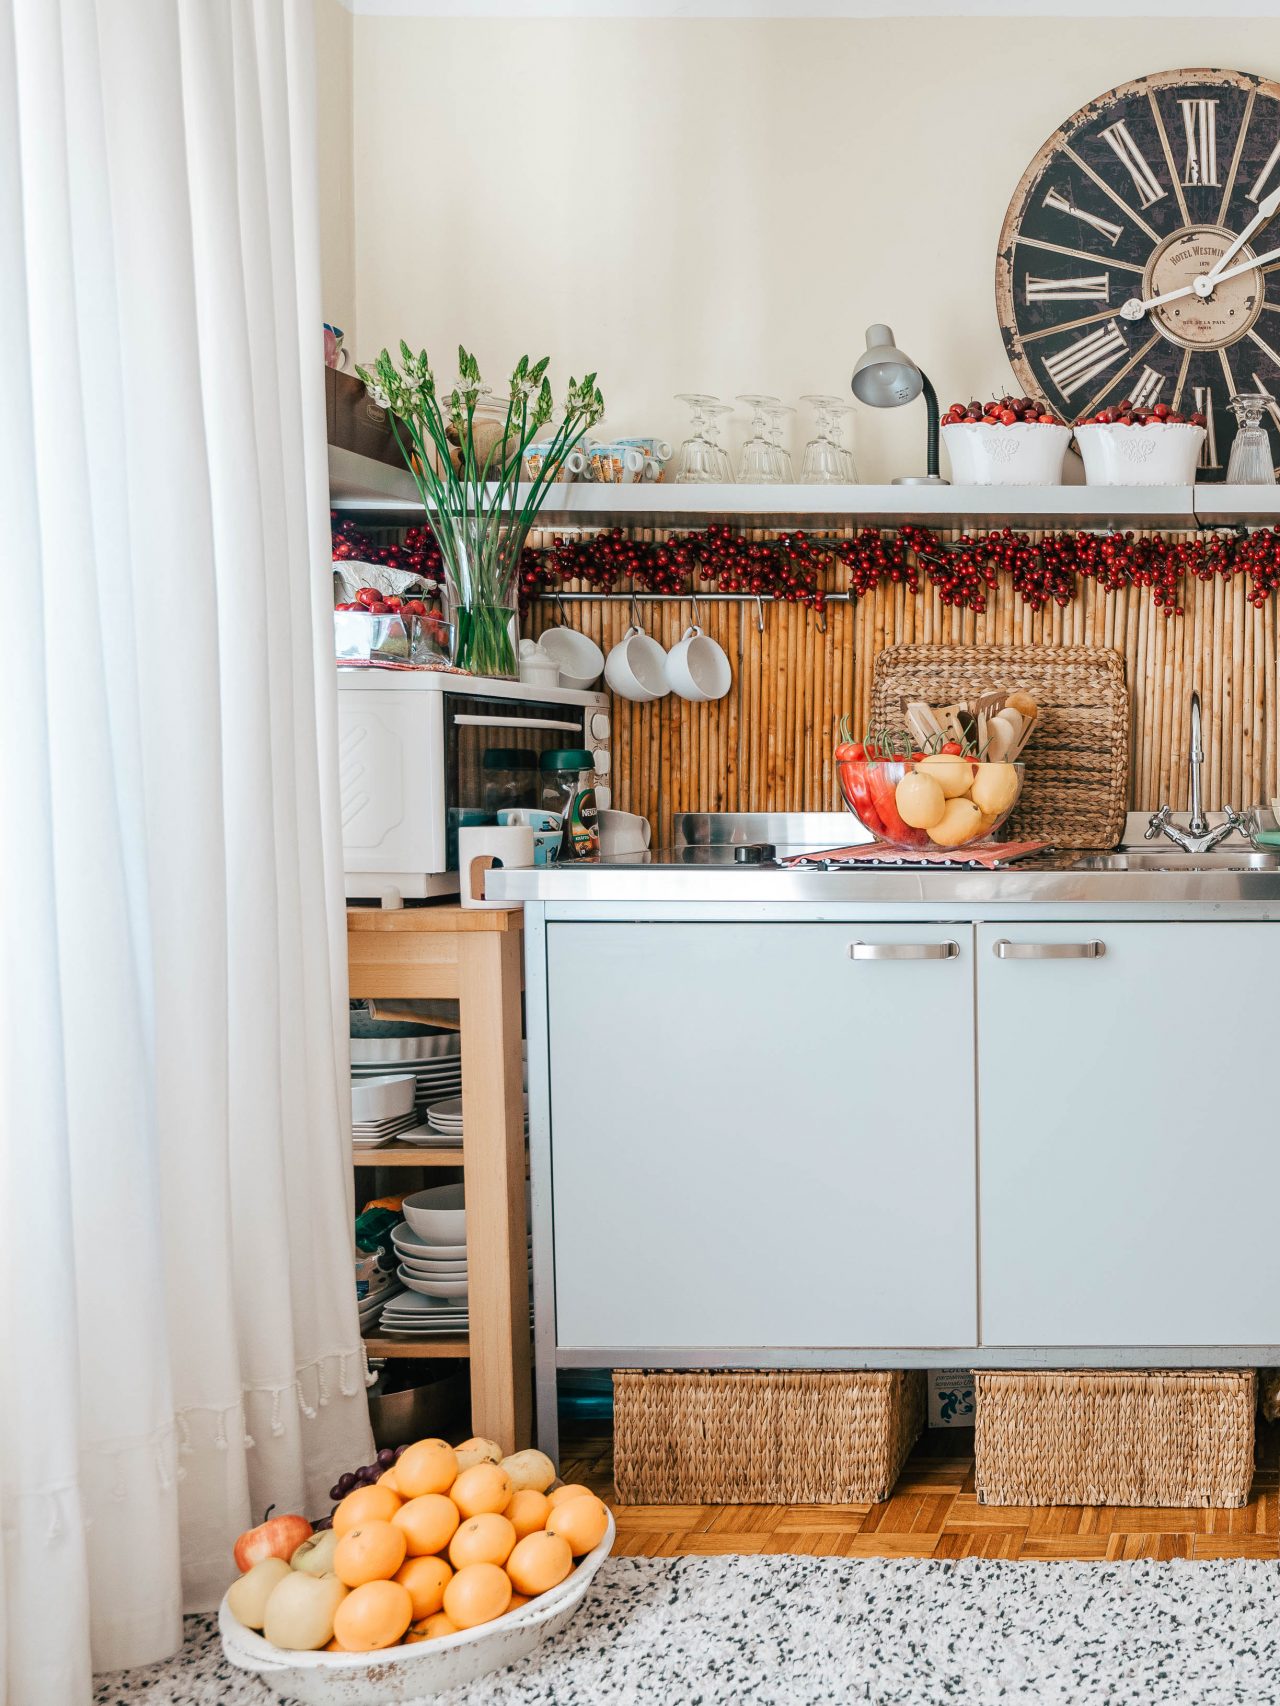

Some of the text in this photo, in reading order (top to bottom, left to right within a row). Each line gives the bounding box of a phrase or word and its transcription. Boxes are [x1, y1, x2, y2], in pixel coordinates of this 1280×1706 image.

[1097, 119, 1168, 210] XI
[1177, 99, 1222, 187] XII
[1042, 186, 1124, 247] X
[1026, 272, 1109, 305] IX
[1170, 246, 1240, 266] HOTEL WESTMINR
[1041, 318, 1130, 404] VIII
